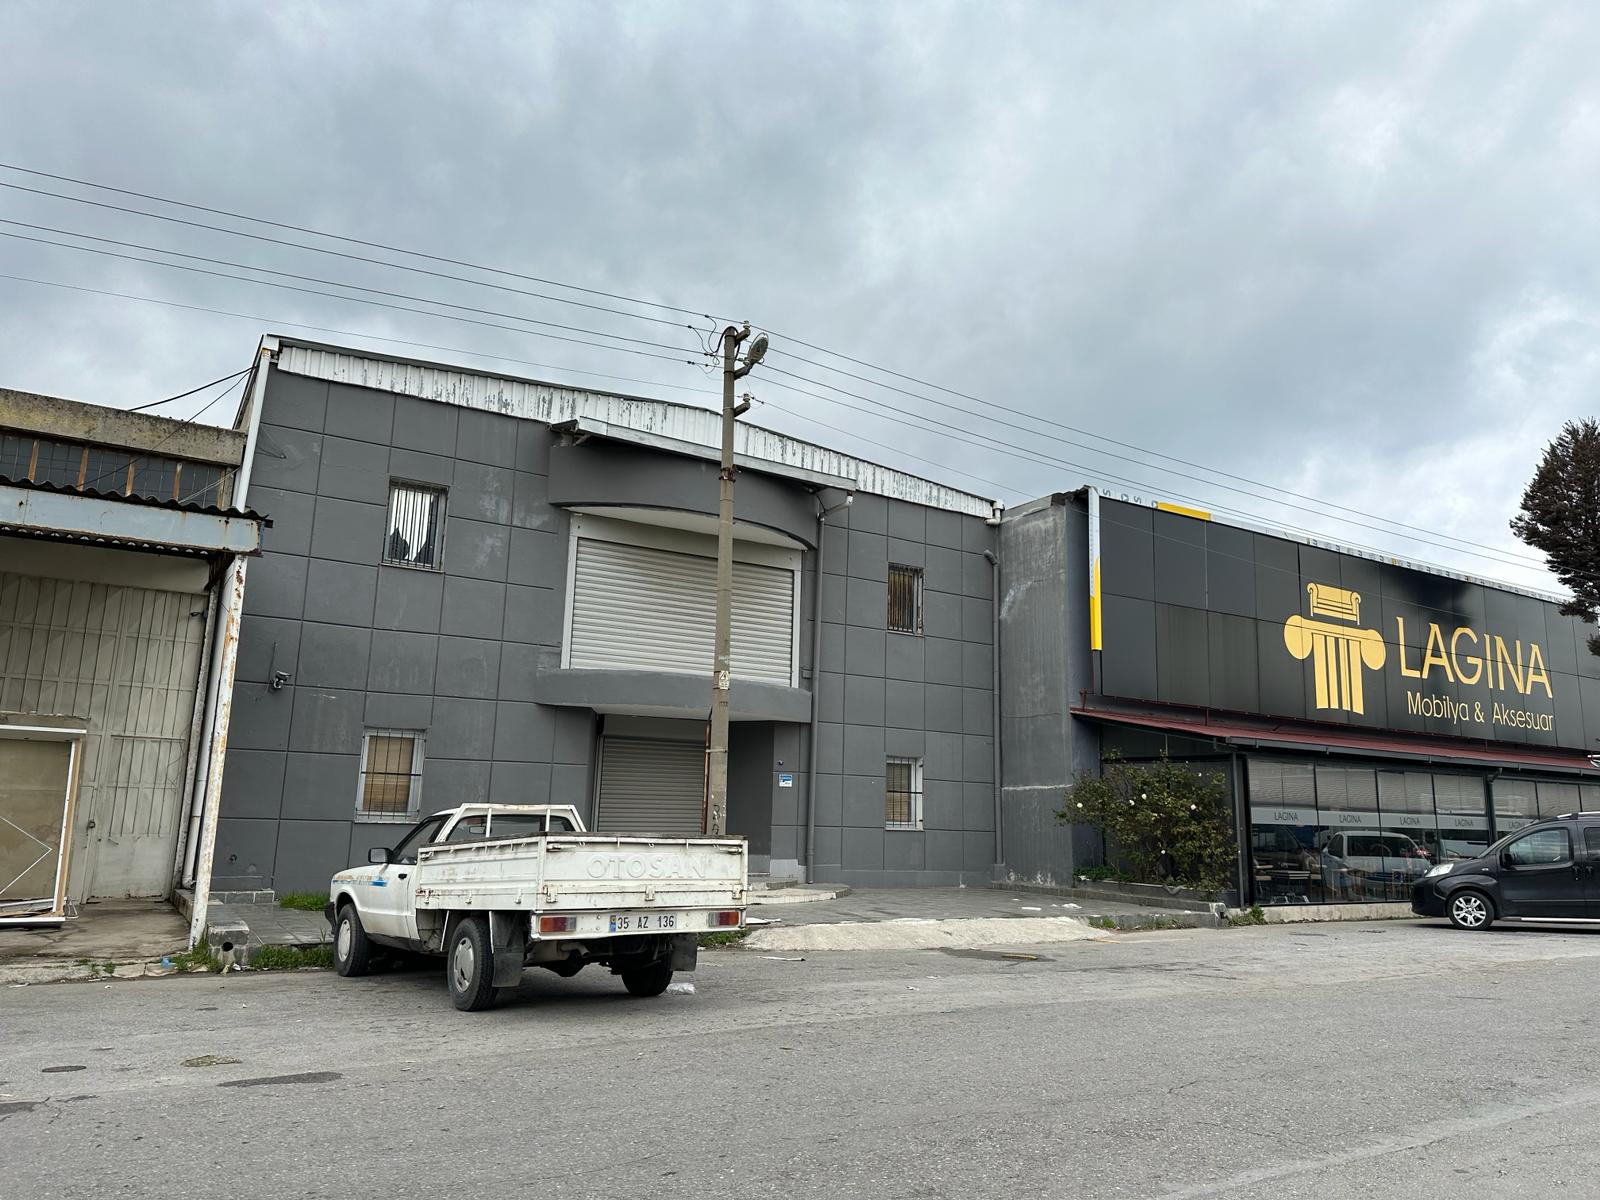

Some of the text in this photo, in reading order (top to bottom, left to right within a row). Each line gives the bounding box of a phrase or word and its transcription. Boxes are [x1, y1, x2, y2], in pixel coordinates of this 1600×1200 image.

[1396, 616, 1553, 698] LAGINA
[1407, 690, 1554, 731] Mobilya & Aksesuar
[1274, 811, 1299, 821] LAGINA
[586, 853, 706, 880] OTOSAN
[617, 915, 675, 930] 35 AZ 136
